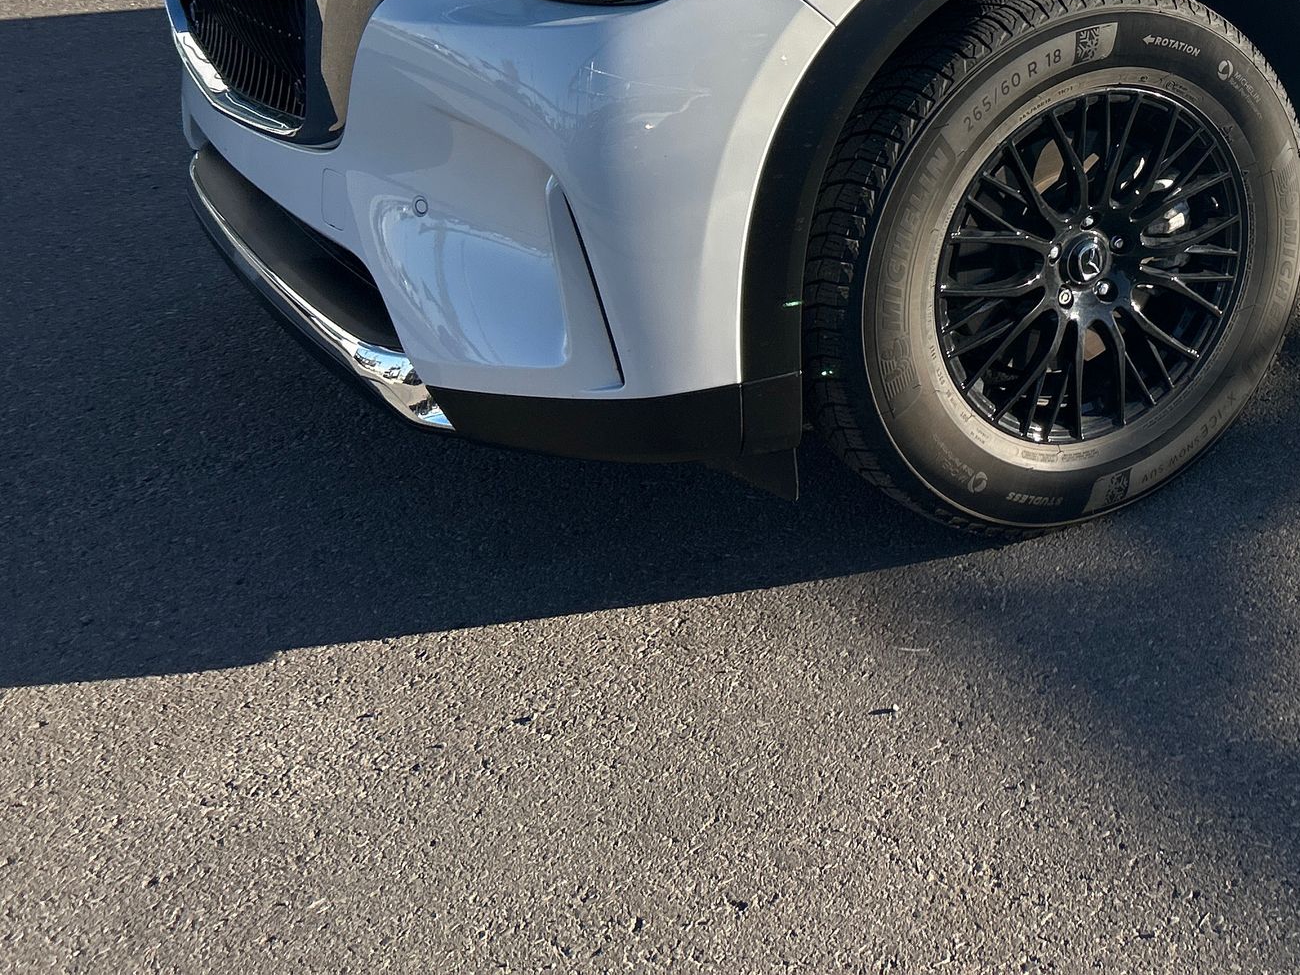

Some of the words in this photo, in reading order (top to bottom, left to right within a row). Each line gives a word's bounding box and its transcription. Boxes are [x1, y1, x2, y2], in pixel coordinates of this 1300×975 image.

[1154, 36, 1201, 57] ROTATION
[963, 72, 1021, 131] 265/60
[1027, 61, 1038, 78] R
[1045, 48, 1062, 67] 18
[1232, 71, 1264, 105] MICHELIN
[881, 144, 951, 334] MICHELIN
[1005, 491, 1064, 507] STUDLESS
